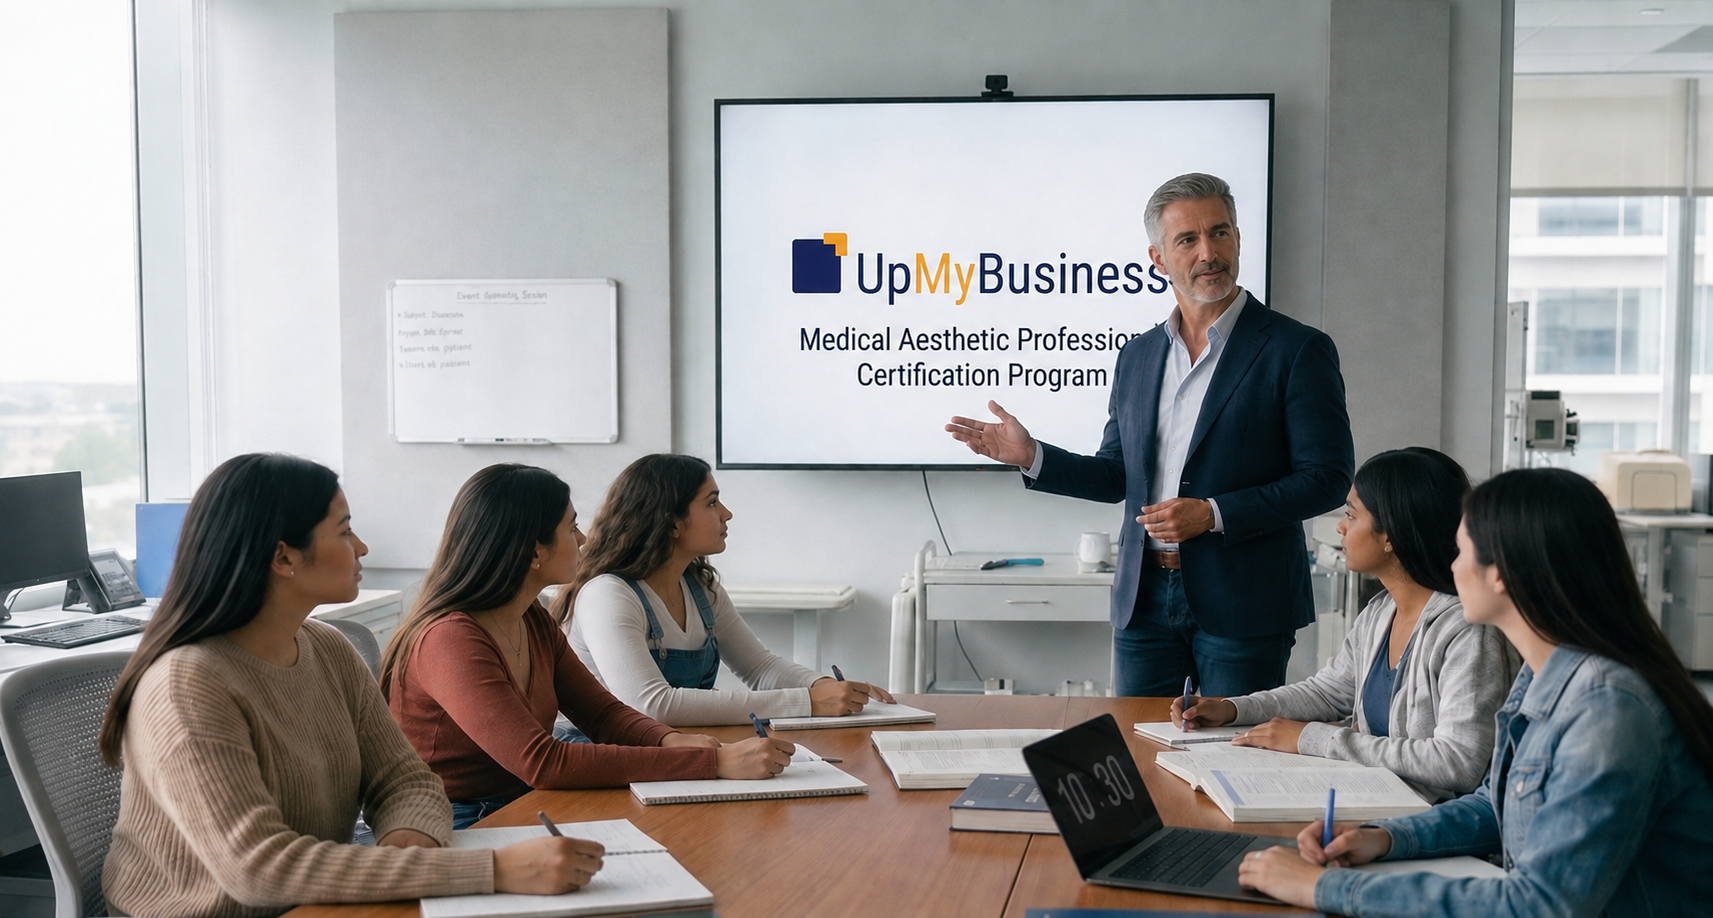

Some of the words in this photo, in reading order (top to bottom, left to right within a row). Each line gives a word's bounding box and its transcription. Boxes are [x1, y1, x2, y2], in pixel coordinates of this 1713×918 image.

[858, 253, 1168, 305] UpMyBusiness
[800, 327, 891, 351] Medical
[898, 327, 1010, 351] Aesthetic
[1017, 324, 1158, 351] Professio
[857, 362, 1000, 387] Certification
[1008, 362, 1108, 392] Program
